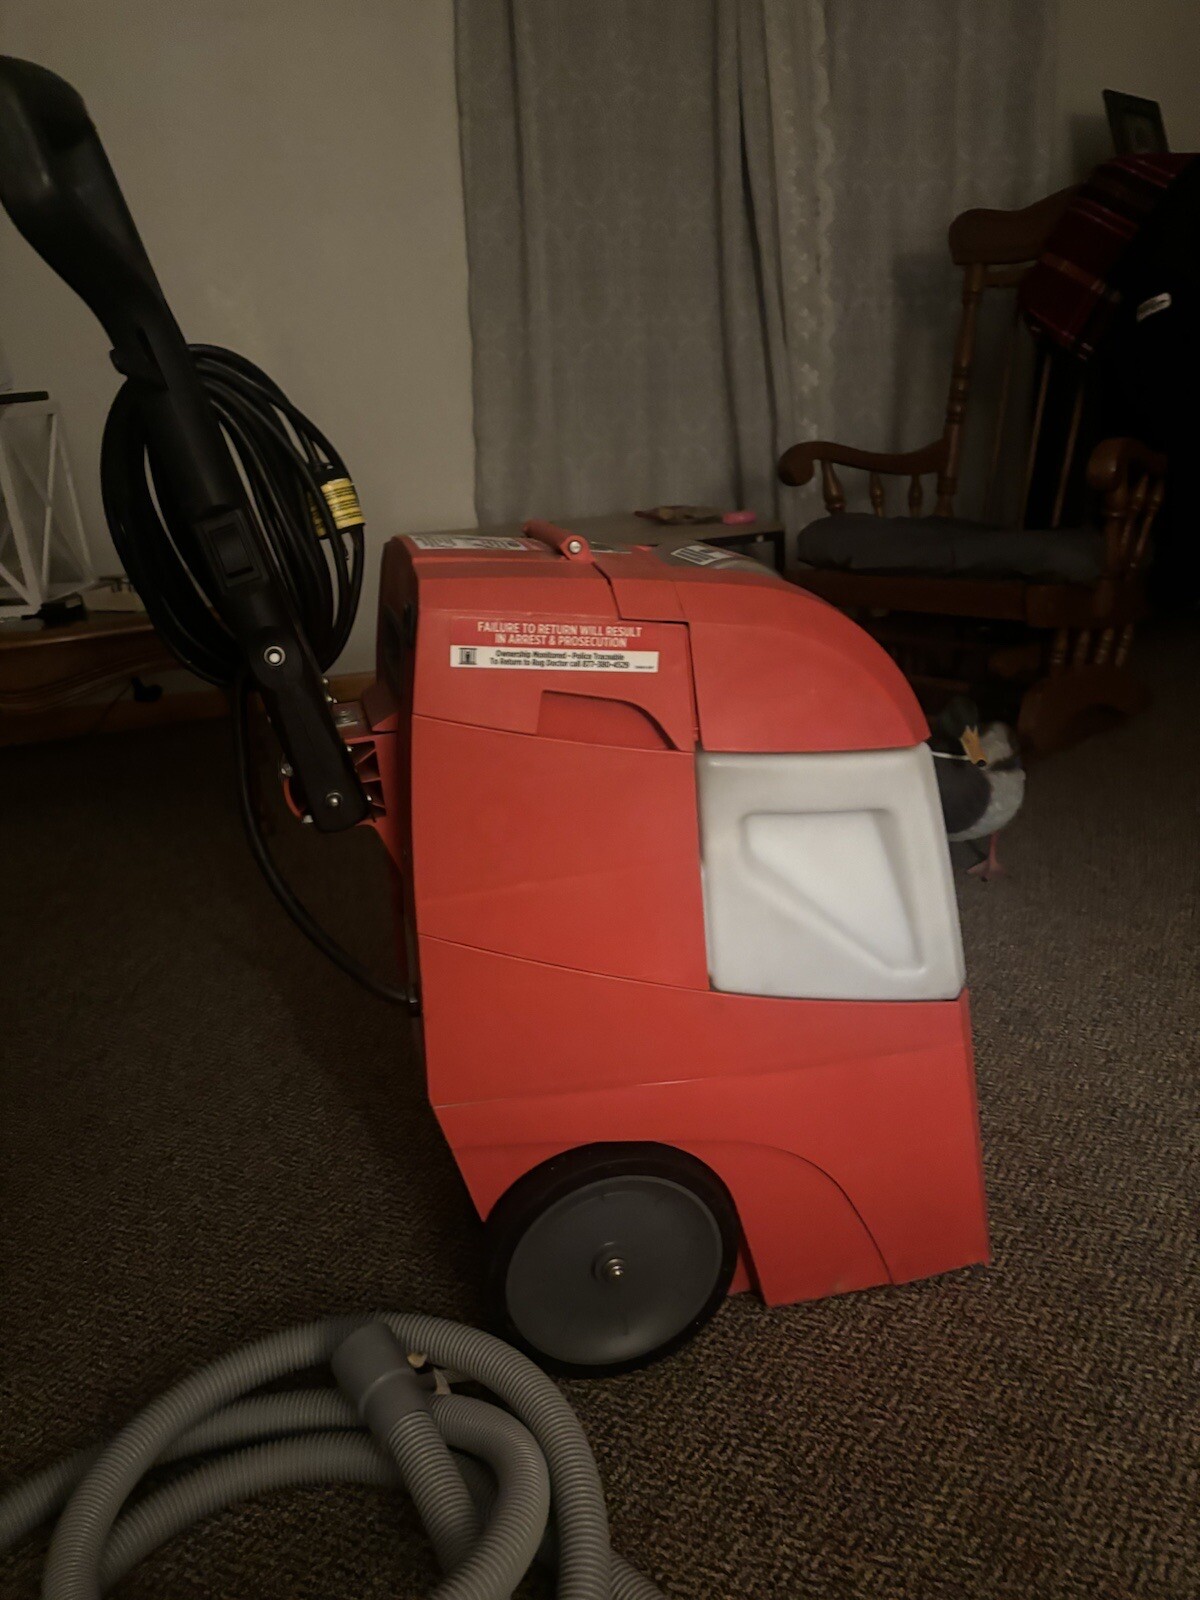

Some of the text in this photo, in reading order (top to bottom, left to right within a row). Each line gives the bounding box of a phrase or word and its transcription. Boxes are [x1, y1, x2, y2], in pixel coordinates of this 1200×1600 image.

[477, 621, 643, 638] FAILURE TO RETURN WILL RESULT
[495, 633, 628, 647] IN ARREST & PROSECUTION
[490, 657, 498, 665] To
[500, 658, 522, 666] Return
[546, 659, 568, 667] Doctor
